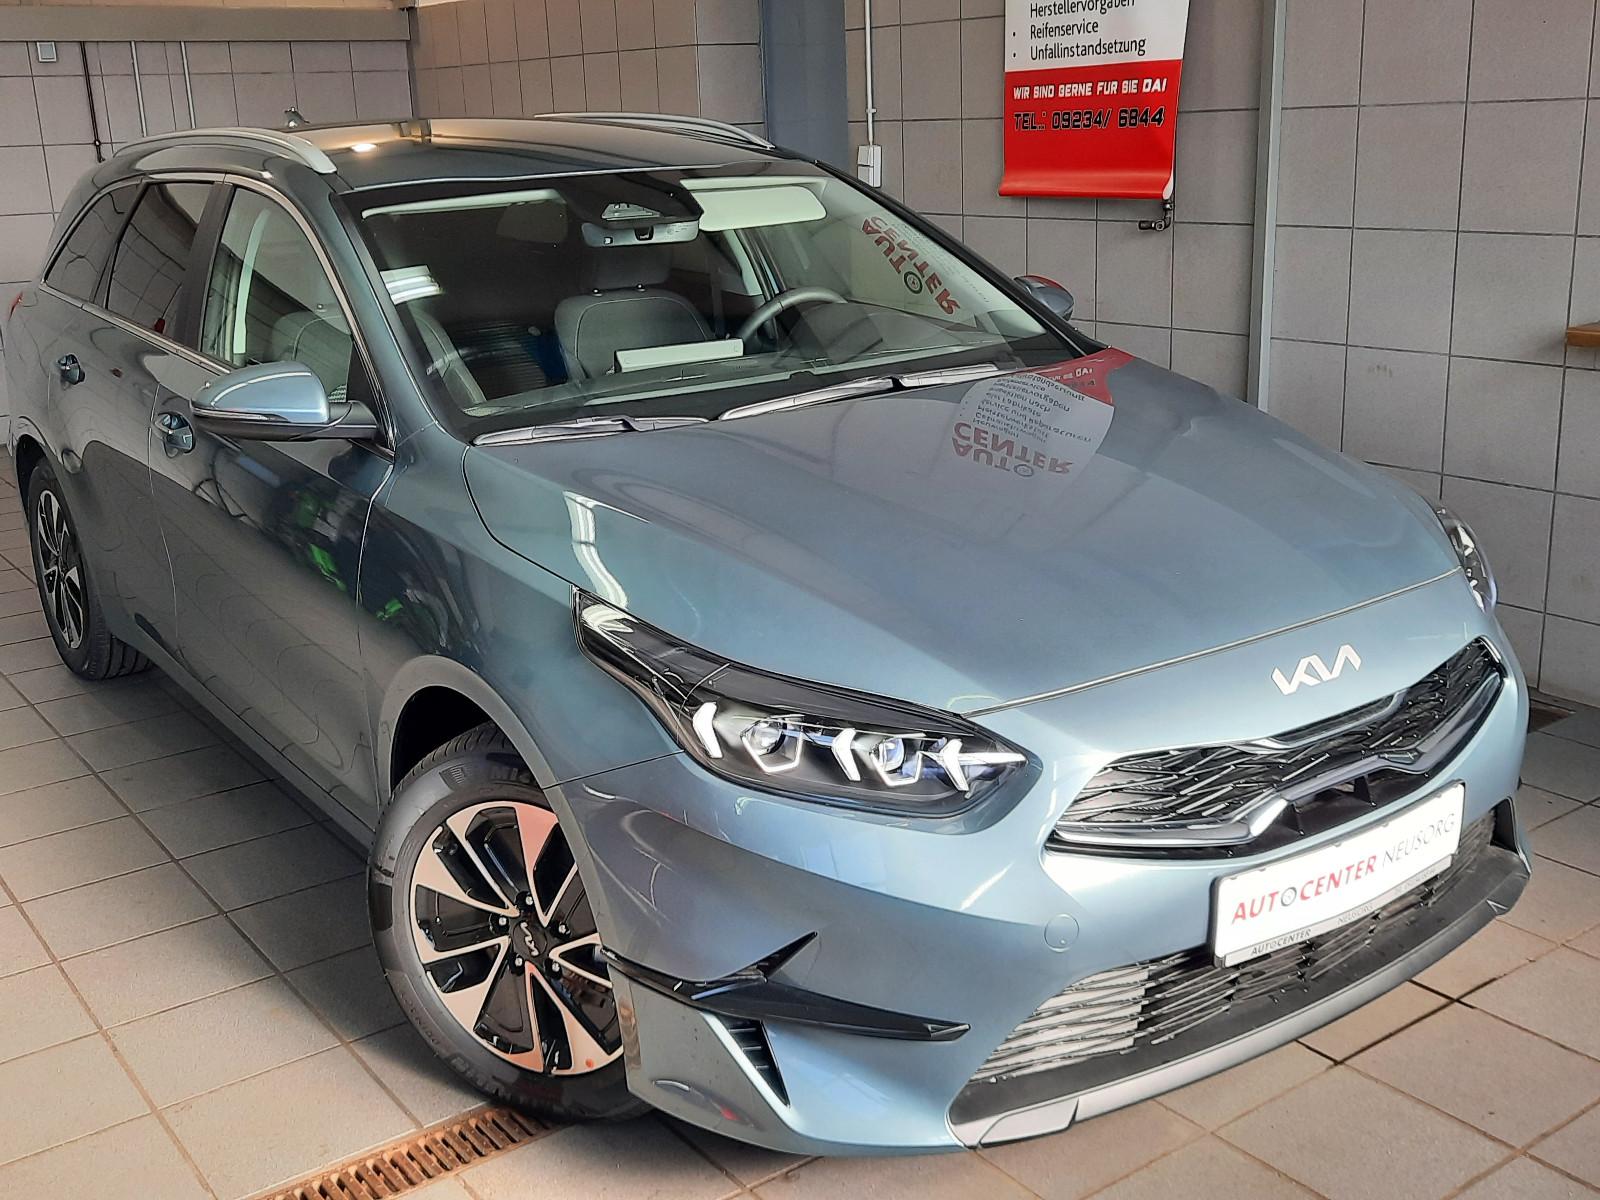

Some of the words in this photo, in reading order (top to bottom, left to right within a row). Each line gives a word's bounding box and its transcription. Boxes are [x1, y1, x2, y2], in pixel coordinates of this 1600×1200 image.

[1030, 18, 1099, 40] Reifenservice
[1030, 38, 1147, 60] Unfallinstandsetzung
[1013, 86, 1031, 100] WIR
[1033, 85, 1055, 99] SIND
[1058, 82, 1093, 97] GERNE
[1121, 79, 1139, 94] SIE
[1142, 78, 1167, 93] DA!
[1051, 108, 1112, 130] 09234/
[1117, 106, 1165, 129] 6844
[1271, 644, 1362, 696] KIA
[1382, 813, 1455, 867] NEUSORG
